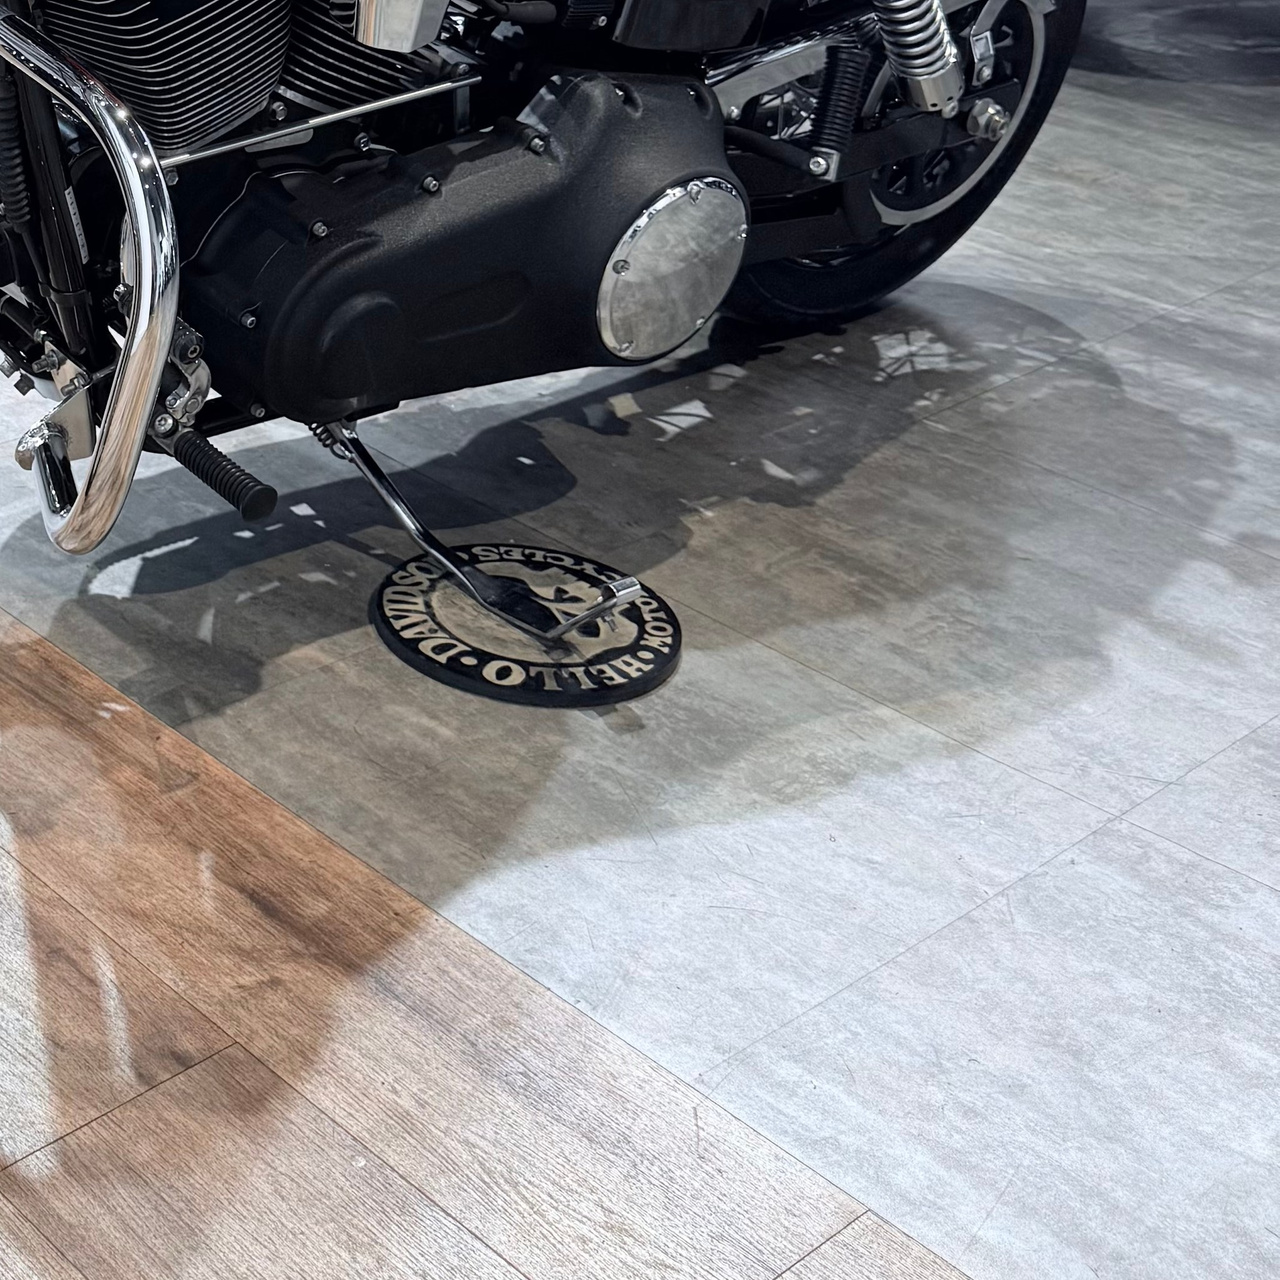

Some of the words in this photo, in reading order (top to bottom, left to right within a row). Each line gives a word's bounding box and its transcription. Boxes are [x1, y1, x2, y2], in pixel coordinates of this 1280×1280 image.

[382, 560, 473, 666] DAVIDSO
[471, 546, 675, 654] MOTOCYCLES
[481, 653, 656, 691] HELLO
